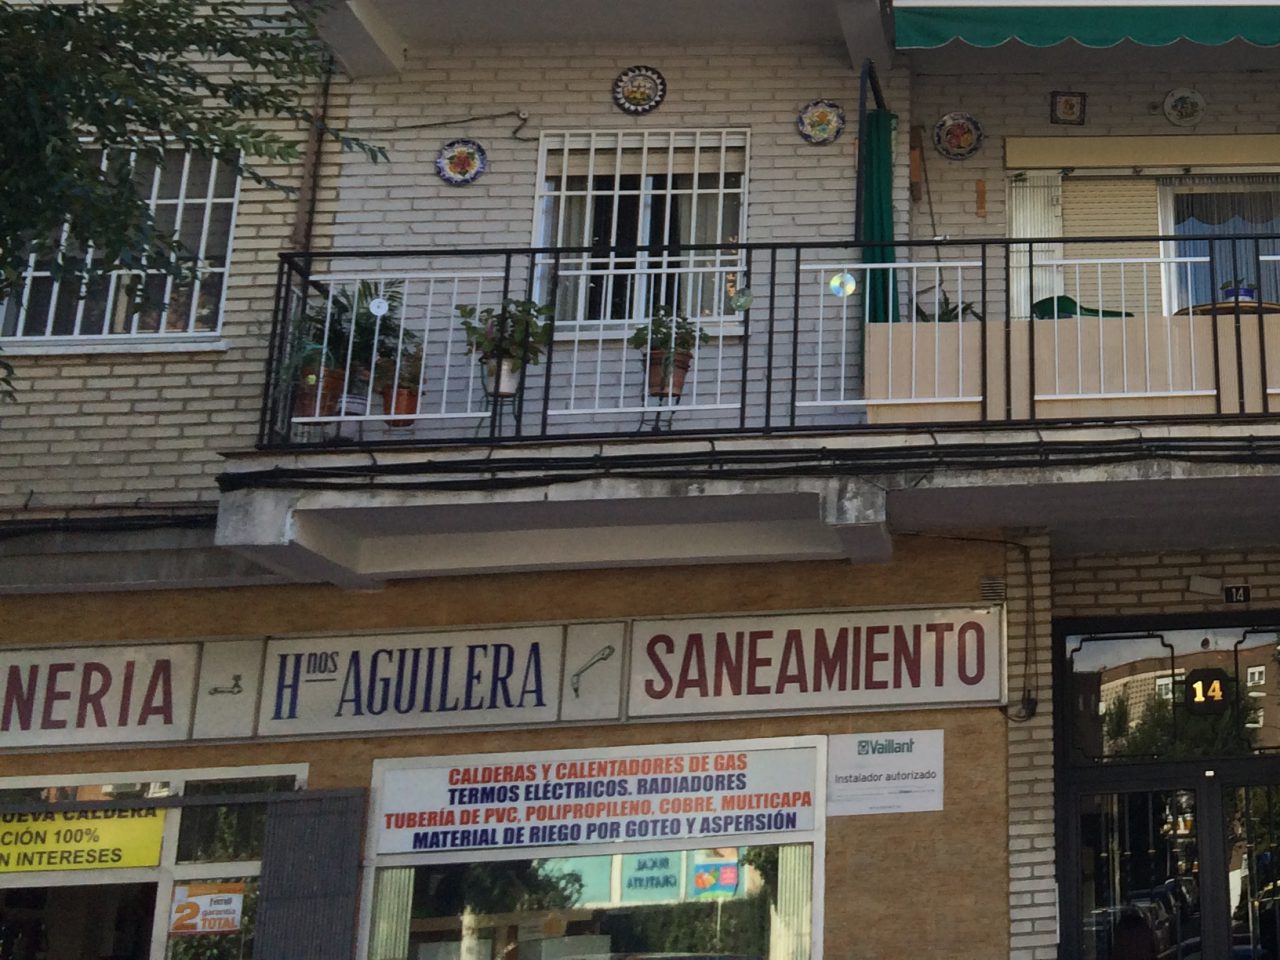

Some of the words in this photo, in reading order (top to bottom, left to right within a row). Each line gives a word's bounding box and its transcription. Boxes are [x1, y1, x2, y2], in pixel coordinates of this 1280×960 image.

[1232, 587, 1244, 602] 14
[645, 620, 986, 700] SANEAMIENTO
[335, 641, 547, 717] AGUILERA
[1192, 680, 1223, 702] 14
[0, 658, 173, 732] NERIA
[870, 738, 915, 754] Vaillant
[448, 763, 537, 785] CALDERAS
[542, 763, 552, 780] Y
[555, 757, 684, 780] CALENTADORES
[688, 755, 709, 773] DE
[713, 753, 747, 771] GAS
[834, 772, 882, 783] Instalador
[885, 770, 936, 782] autorizado
[448, 785, 520, 805] TERMOS
[636, 773, 747, 795] RADIADORES
[384, 808, 455, 829] TUBERÍA
[459, 809, 480, 825] DE
[484, 807, 521, 824] PVC,
[721, 791, 812, 811] MULTICAPA
[0, 827, 47, 846] CIÓN
[54, 827, 99, 844] 100%
[412, 828, 499, 849] MATERIAL
[502, 827, 525, 845] DE
[529, 823, 581, 842] RIEGO
[585, 821, 621, 840] POR
[625, 818, 681, 838] GOTEO
[685, 817, 697, 834] Y
[699, 809, 797, 834] ASPERSIÓN
[16, 848, 122, 867] INTERESES
[172, 901, 200, 931] 2
